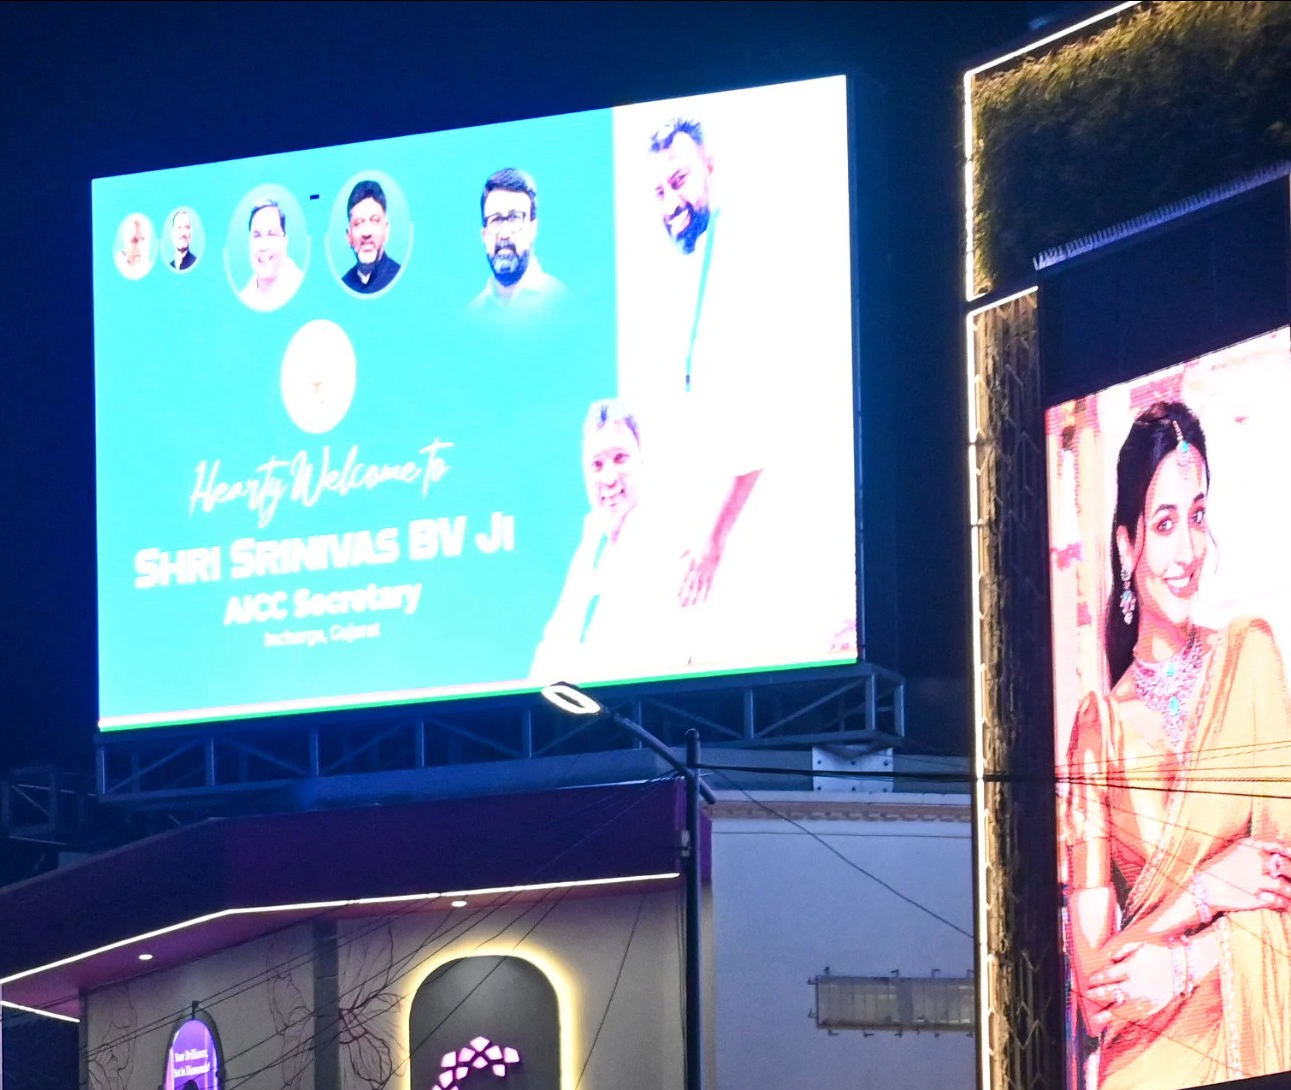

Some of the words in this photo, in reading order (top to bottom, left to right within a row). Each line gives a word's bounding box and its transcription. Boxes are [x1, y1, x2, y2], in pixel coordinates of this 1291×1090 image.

[189, 458, 290, 528] Hearty
[289, 445, 422, 507] Welcome
[134, 546, 222, 589] SHRI
[230, 528, 401, 580] SRINIVAS
[408, 515, 467, 561] BV
[223, 590, 288, 625] AICC
[293, 583, 423, 617] Secretary
